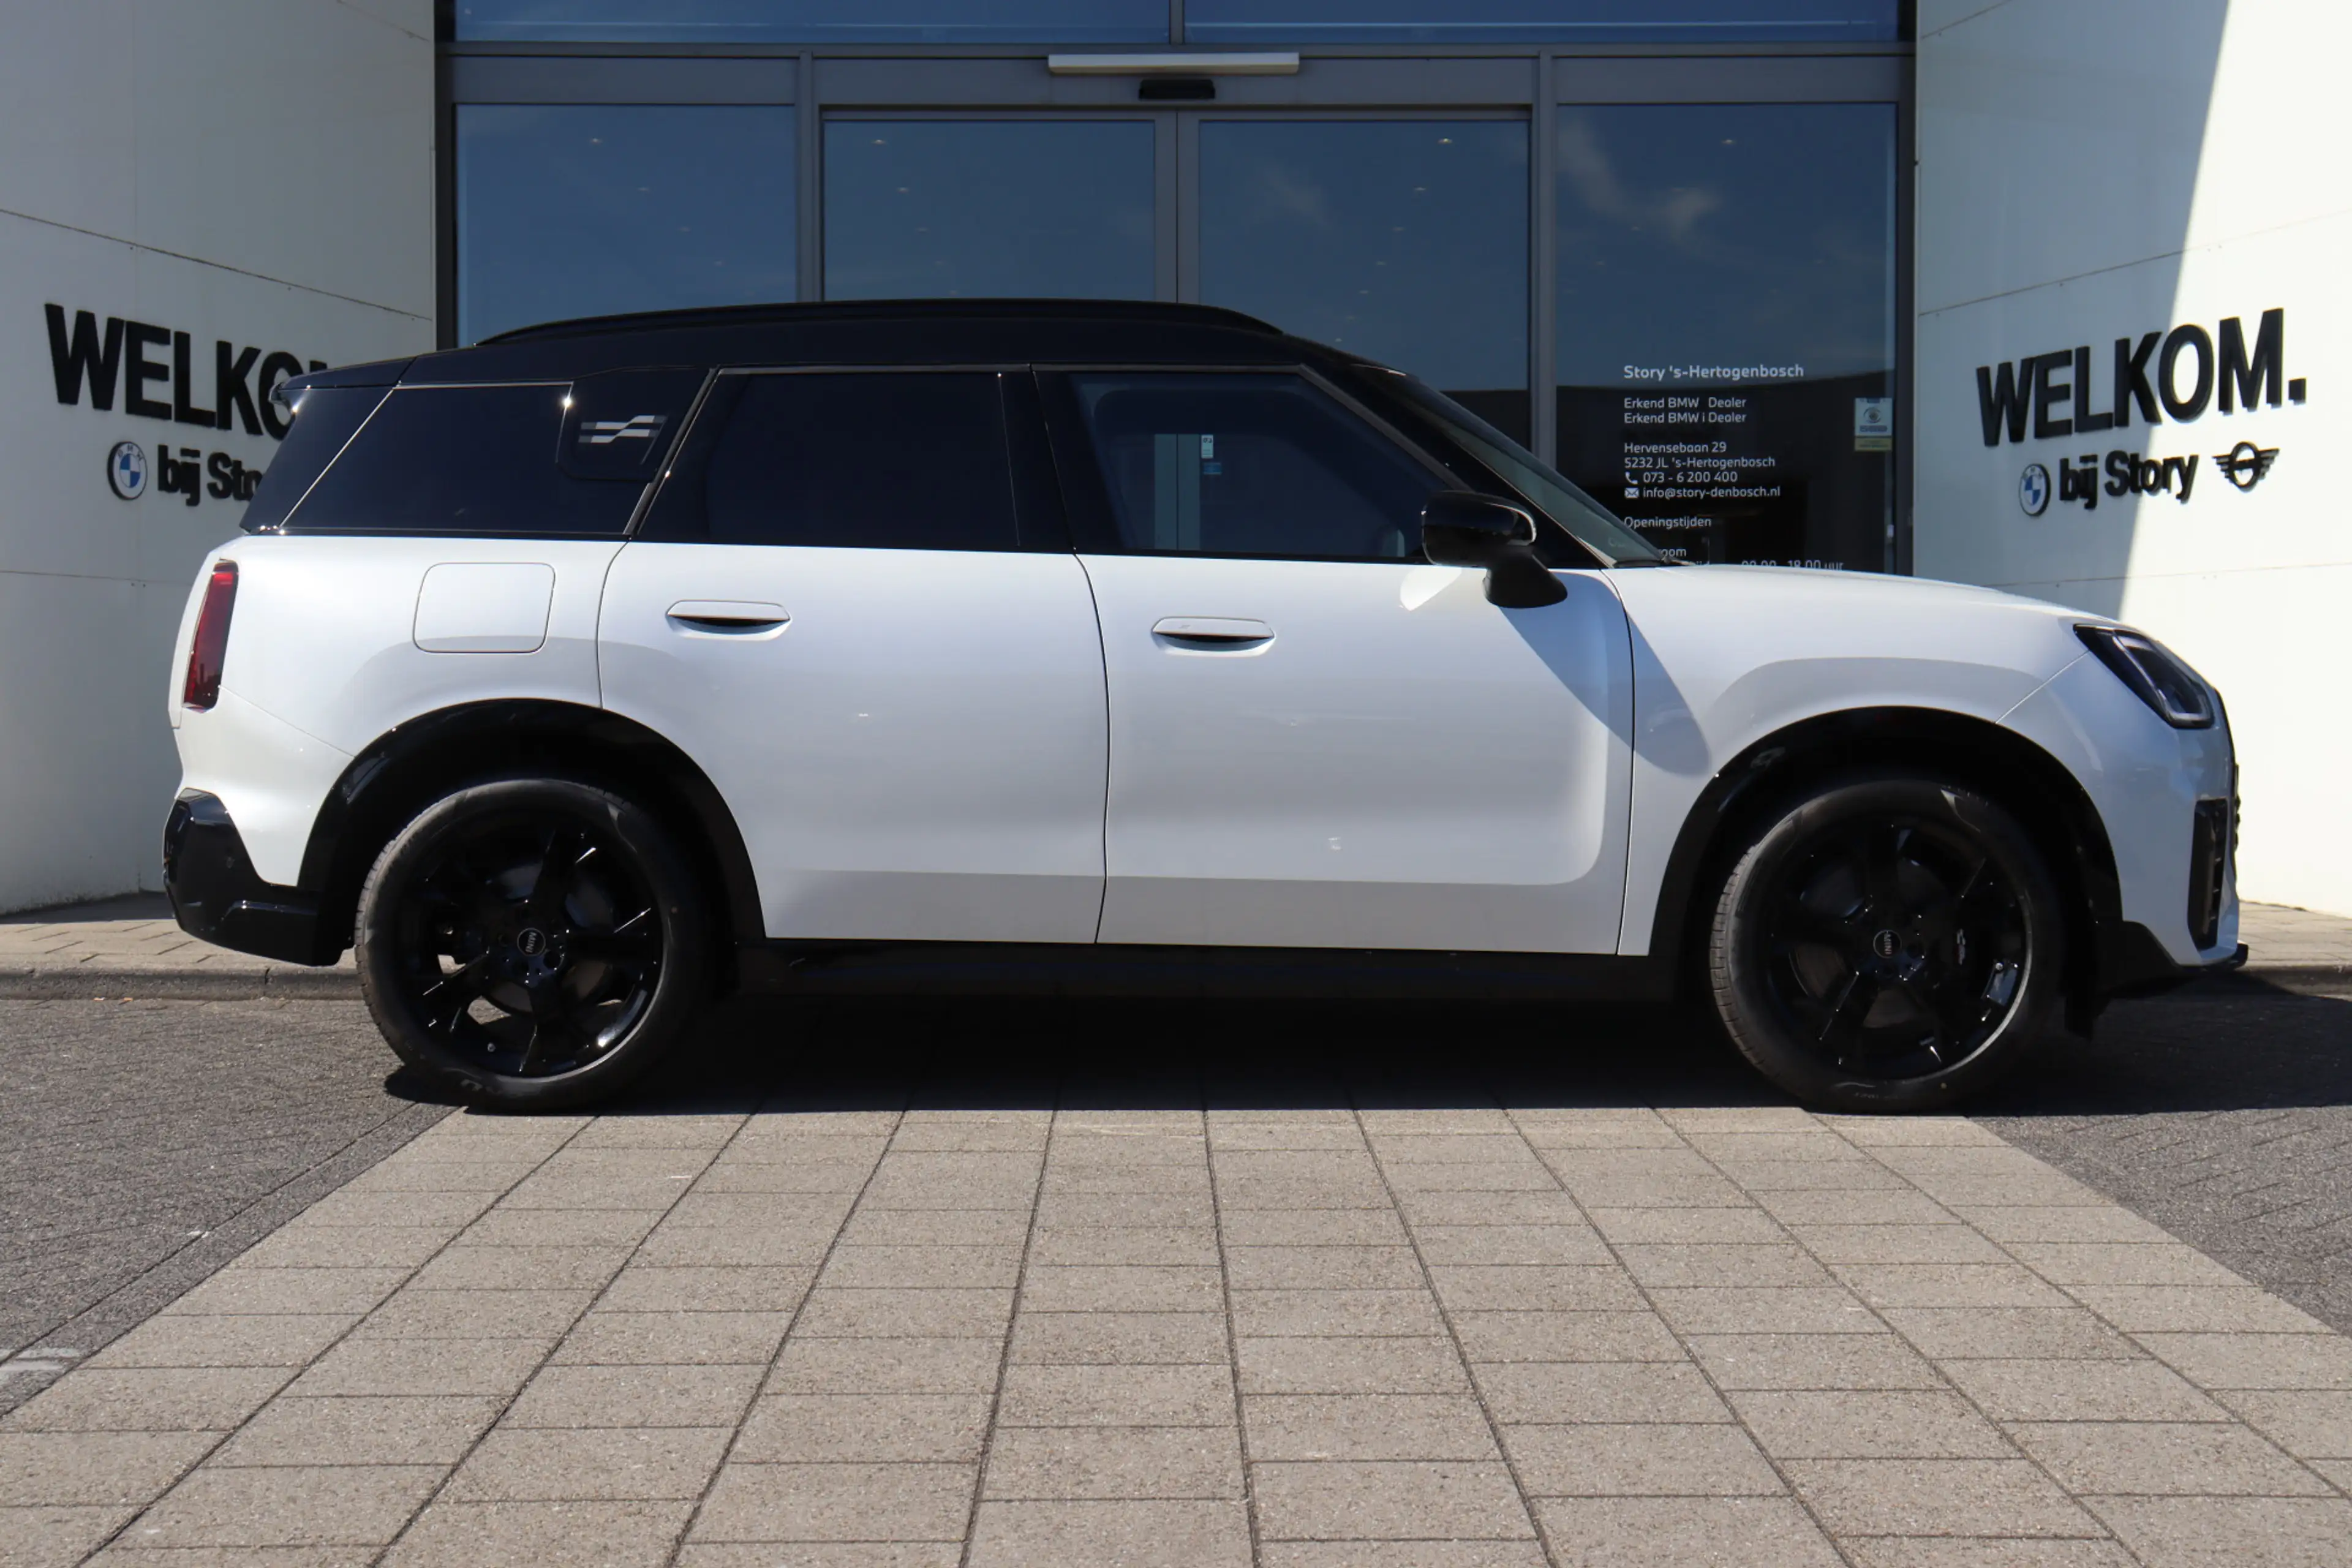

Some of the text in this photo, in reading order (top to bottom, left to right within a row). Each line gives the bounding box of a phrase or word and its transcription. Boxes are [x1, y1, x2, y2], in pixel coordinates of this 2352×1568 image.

[45, 303, 328, 441] WELKO
[1624, 363, 1804, 382] Story 's-Hertogenbosch
[1976, 307, 2306, 448] WELKOM.
[1624, 396, 1746, 409] Erkend BMW Dealer
[1624, 411, 1746, 424] Erkend BMW i Dealer
[1624, 441, 1727, 454] Hervensebaan 29
[1624, 456, 1775, 470] 5232 JL 's-Hertogenbosch
[157, 443, 201, 507] bij
[1643, 472, 1665, 483] 073
[1676, 472, 1684, 483] 6
[1687, 471, 1711, 483] 200
[1713, 471, 1738, 483] 400
[2059, 450, 2199, 510] bij Story
[1643, 486, 1781, 500] info@story-denbosch.nl
[1624, 516, 1711, 530] Openingstijden
